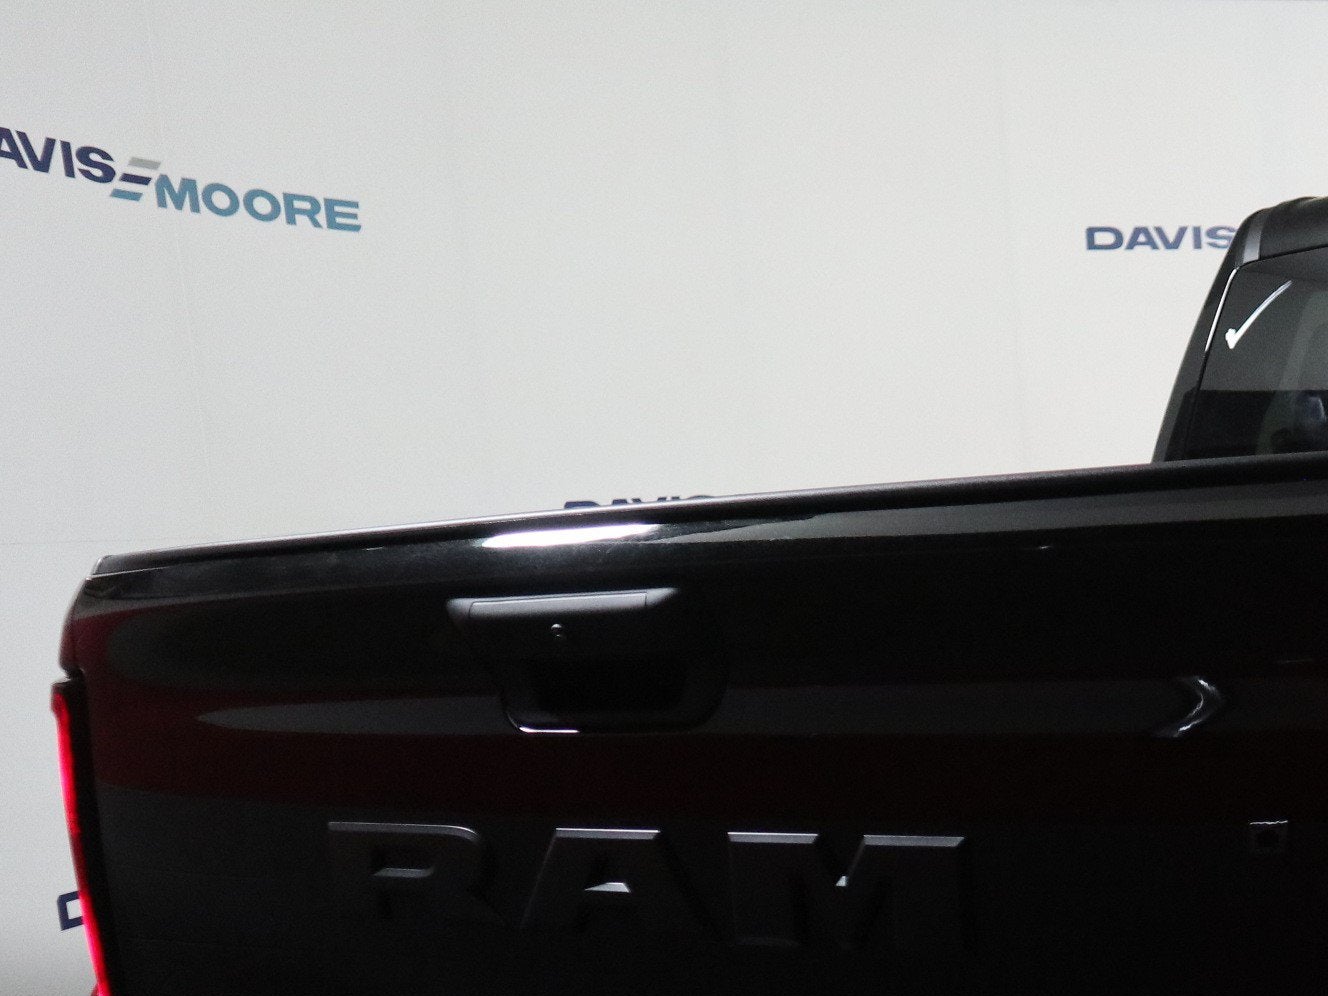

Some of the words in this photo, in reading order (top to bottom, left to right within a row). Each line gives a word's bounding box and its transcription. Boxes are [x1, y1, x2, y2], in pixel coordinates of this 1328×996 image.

[154, 174, 362, 232] MOORE
[1086, 225, 1237, 250] DAVIS
[325, 820, 977, 951] RAM
